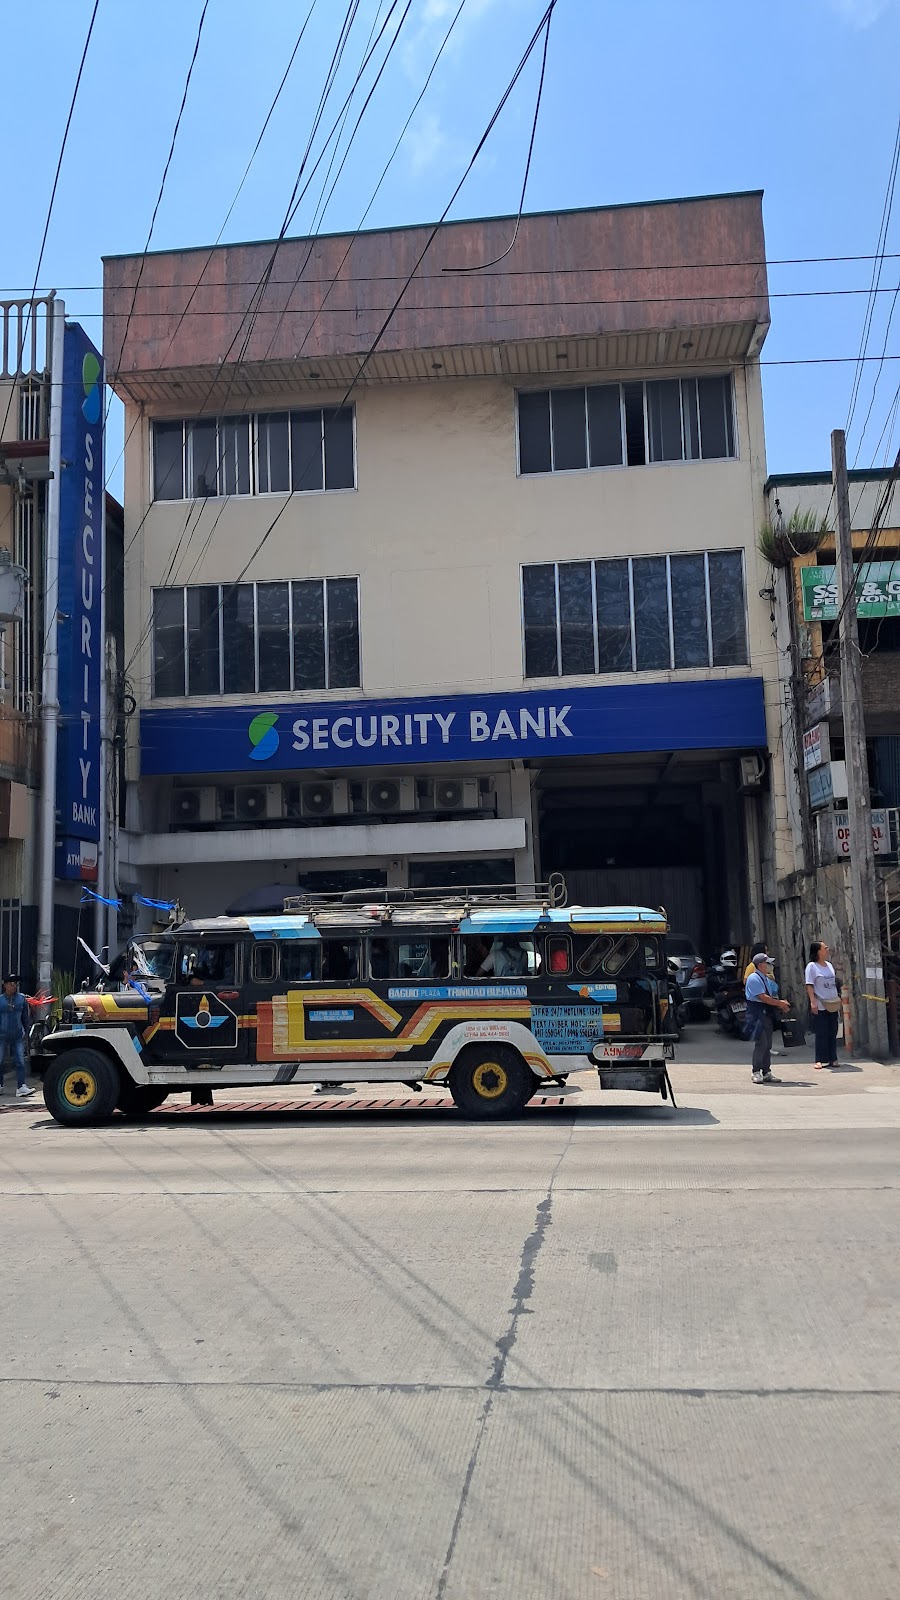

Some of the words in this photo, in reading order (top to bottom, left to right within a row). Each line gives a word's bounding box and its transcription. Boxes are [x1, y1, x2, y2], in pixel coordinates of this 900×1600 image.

[813, 594, 893, 606] PEION
[79, 432, 95, 799] SECURITY
[292, 711, 456, 750] SECURITY
[470, 705, 574, 742] BANK
[72, 801, 97, 827] BANK
[388, 989, 419, 998] BAGUIO
[446, 987, 486, 997] TRINIDAD
